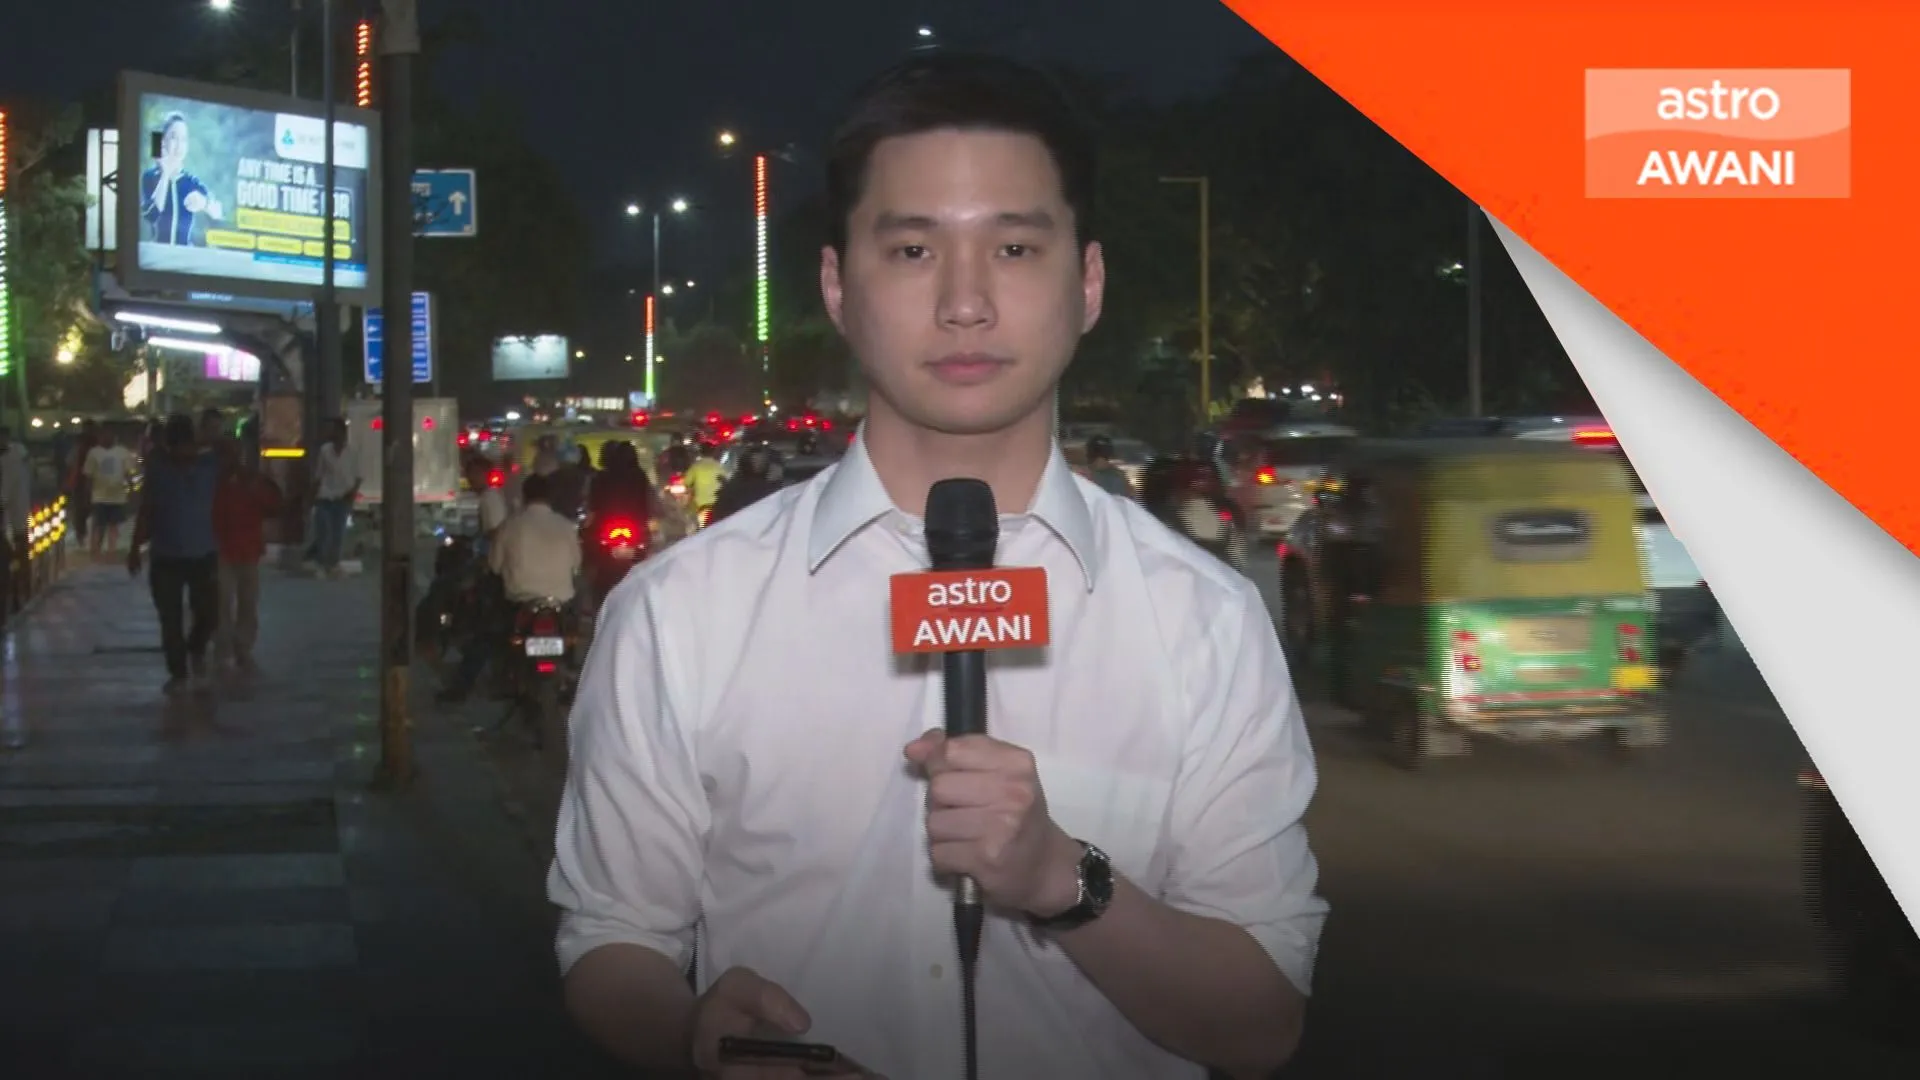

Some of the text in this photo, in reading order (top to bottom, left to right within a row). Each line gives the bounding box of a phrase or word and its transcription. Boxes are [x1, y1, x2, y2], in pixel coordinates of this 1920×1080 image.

[237, 156, 262, 179] ANY
[263, 160, 293, 183] TIME
[293, 165, 306, 185] IS
[237, 180, 279, 209] GOOD
[280, 186, 320, 214] TIME
[927, 577, 1013, 606] astro
[913, 614, 1032, 646] AWANI
